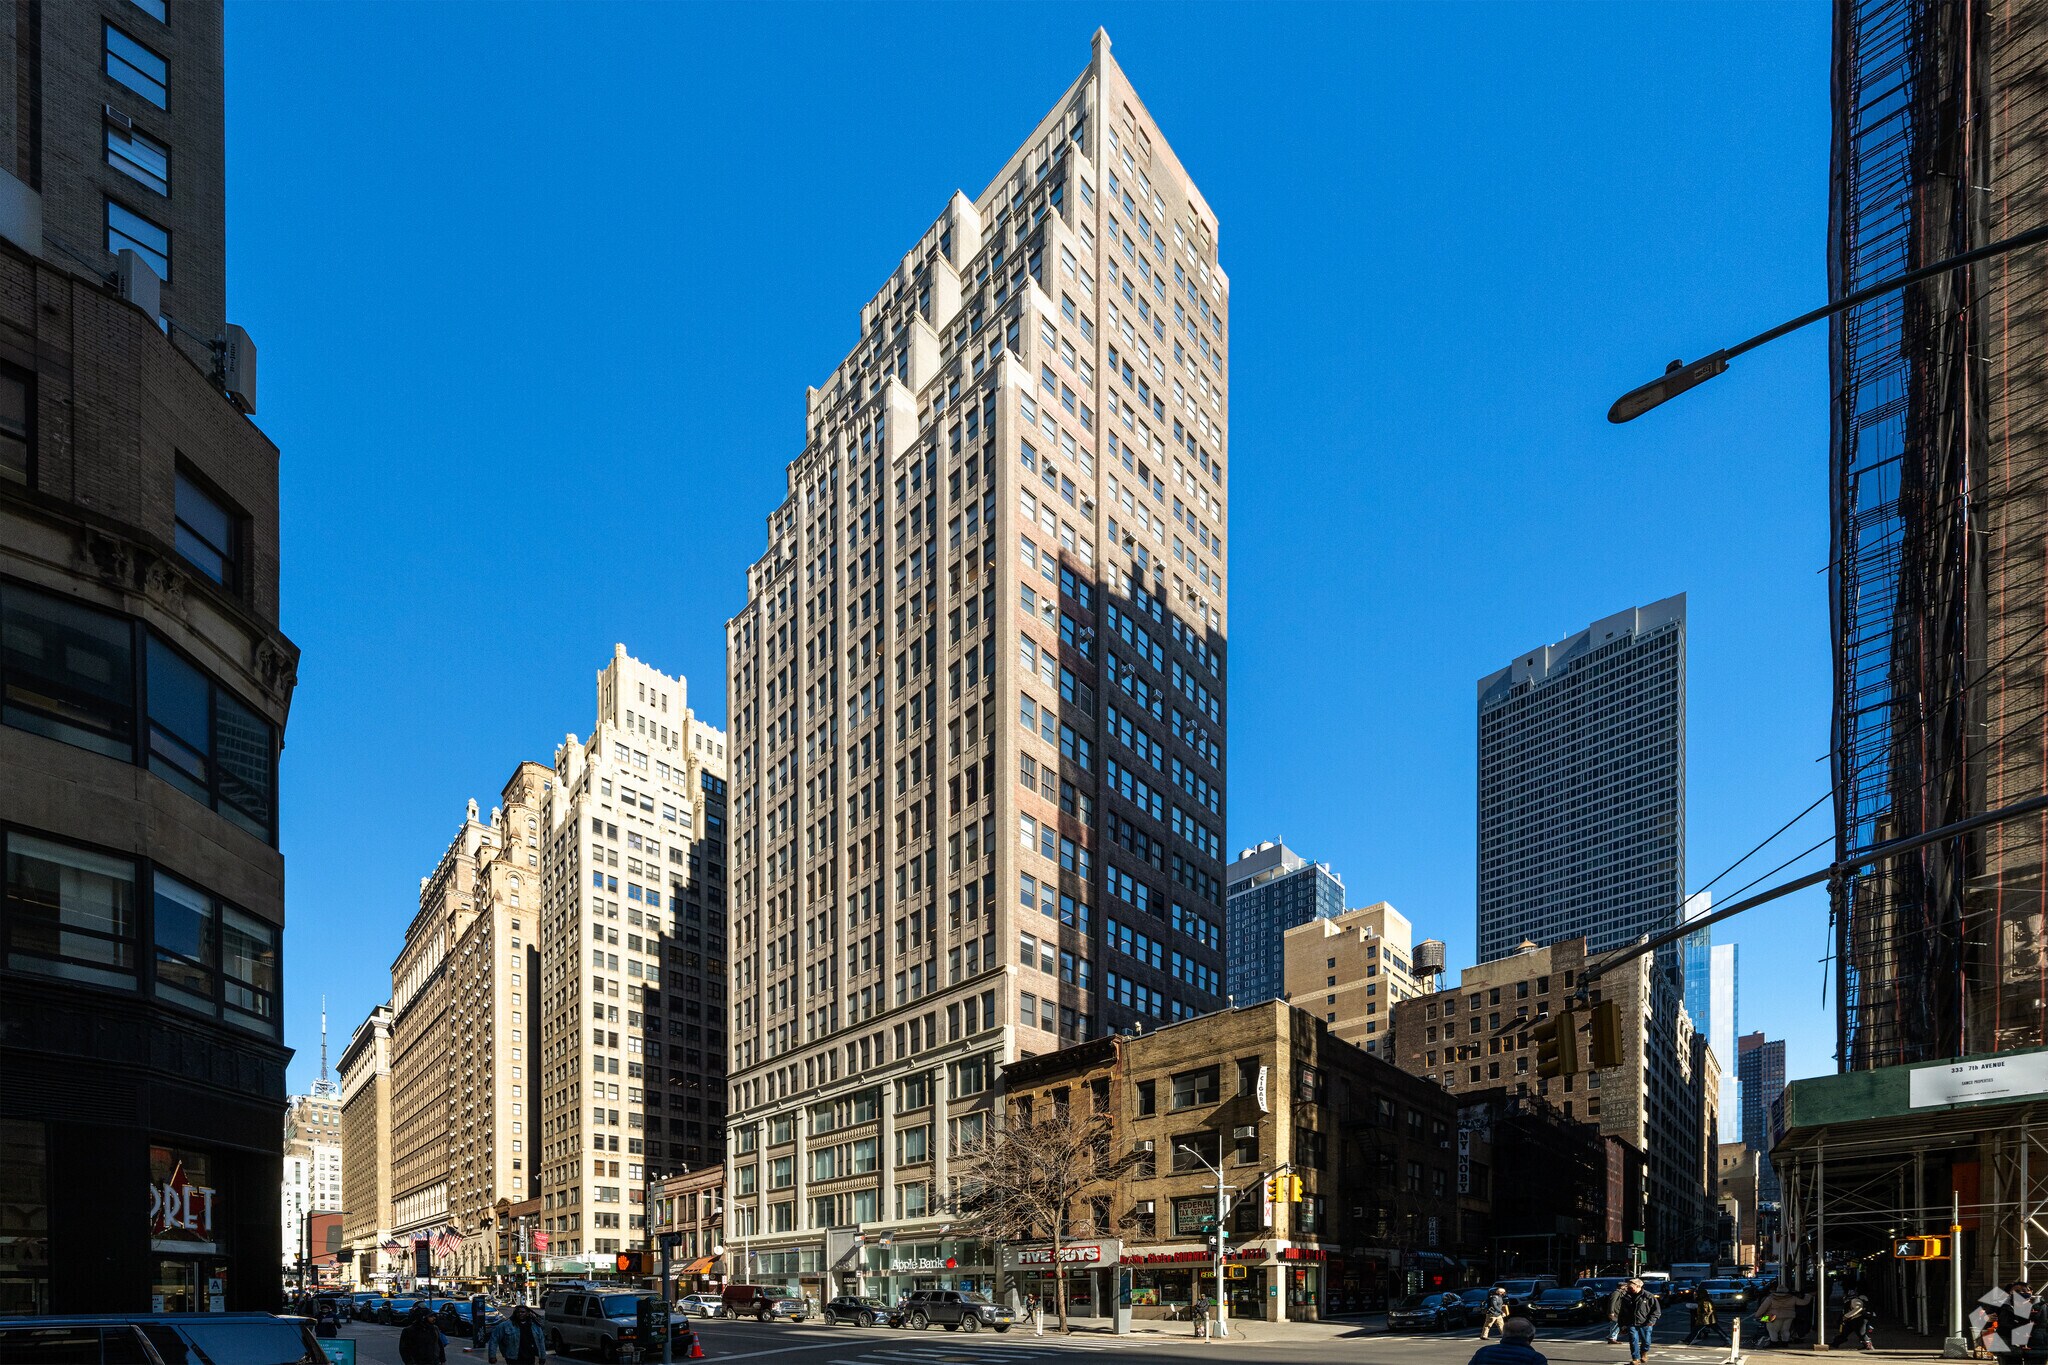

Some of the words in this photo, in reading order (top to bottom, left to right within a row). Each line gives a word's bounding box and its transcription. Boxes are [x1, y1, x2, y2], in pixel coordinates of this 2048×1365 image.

[1981, 1061, 2005, 1070] AVENUE
[1459, 1131, 1468, 1150] NY
[1459, 1154, 1468, 1192] NOBY
[150, 1182, 217, 1232] PRET
[1178, 1200, 1213, 1210] FEDERAL
[1179, 1209, 1189, 1217] TAX
[1190, 1207, 1214, 1216] SERVICE
[1017, 1250, 1051, 1264] FIVE
[1147, 1253, 1172, 1264] Choice
[1173, 1251, 1209, 1263] GOURMET
[1241, 1248, 1267, 1260] PIZZA
[890, 1258, 918, 1273] Apple
[918, 1257, 945, 1269] Bank
[211, 1280, 220, 1290] A
